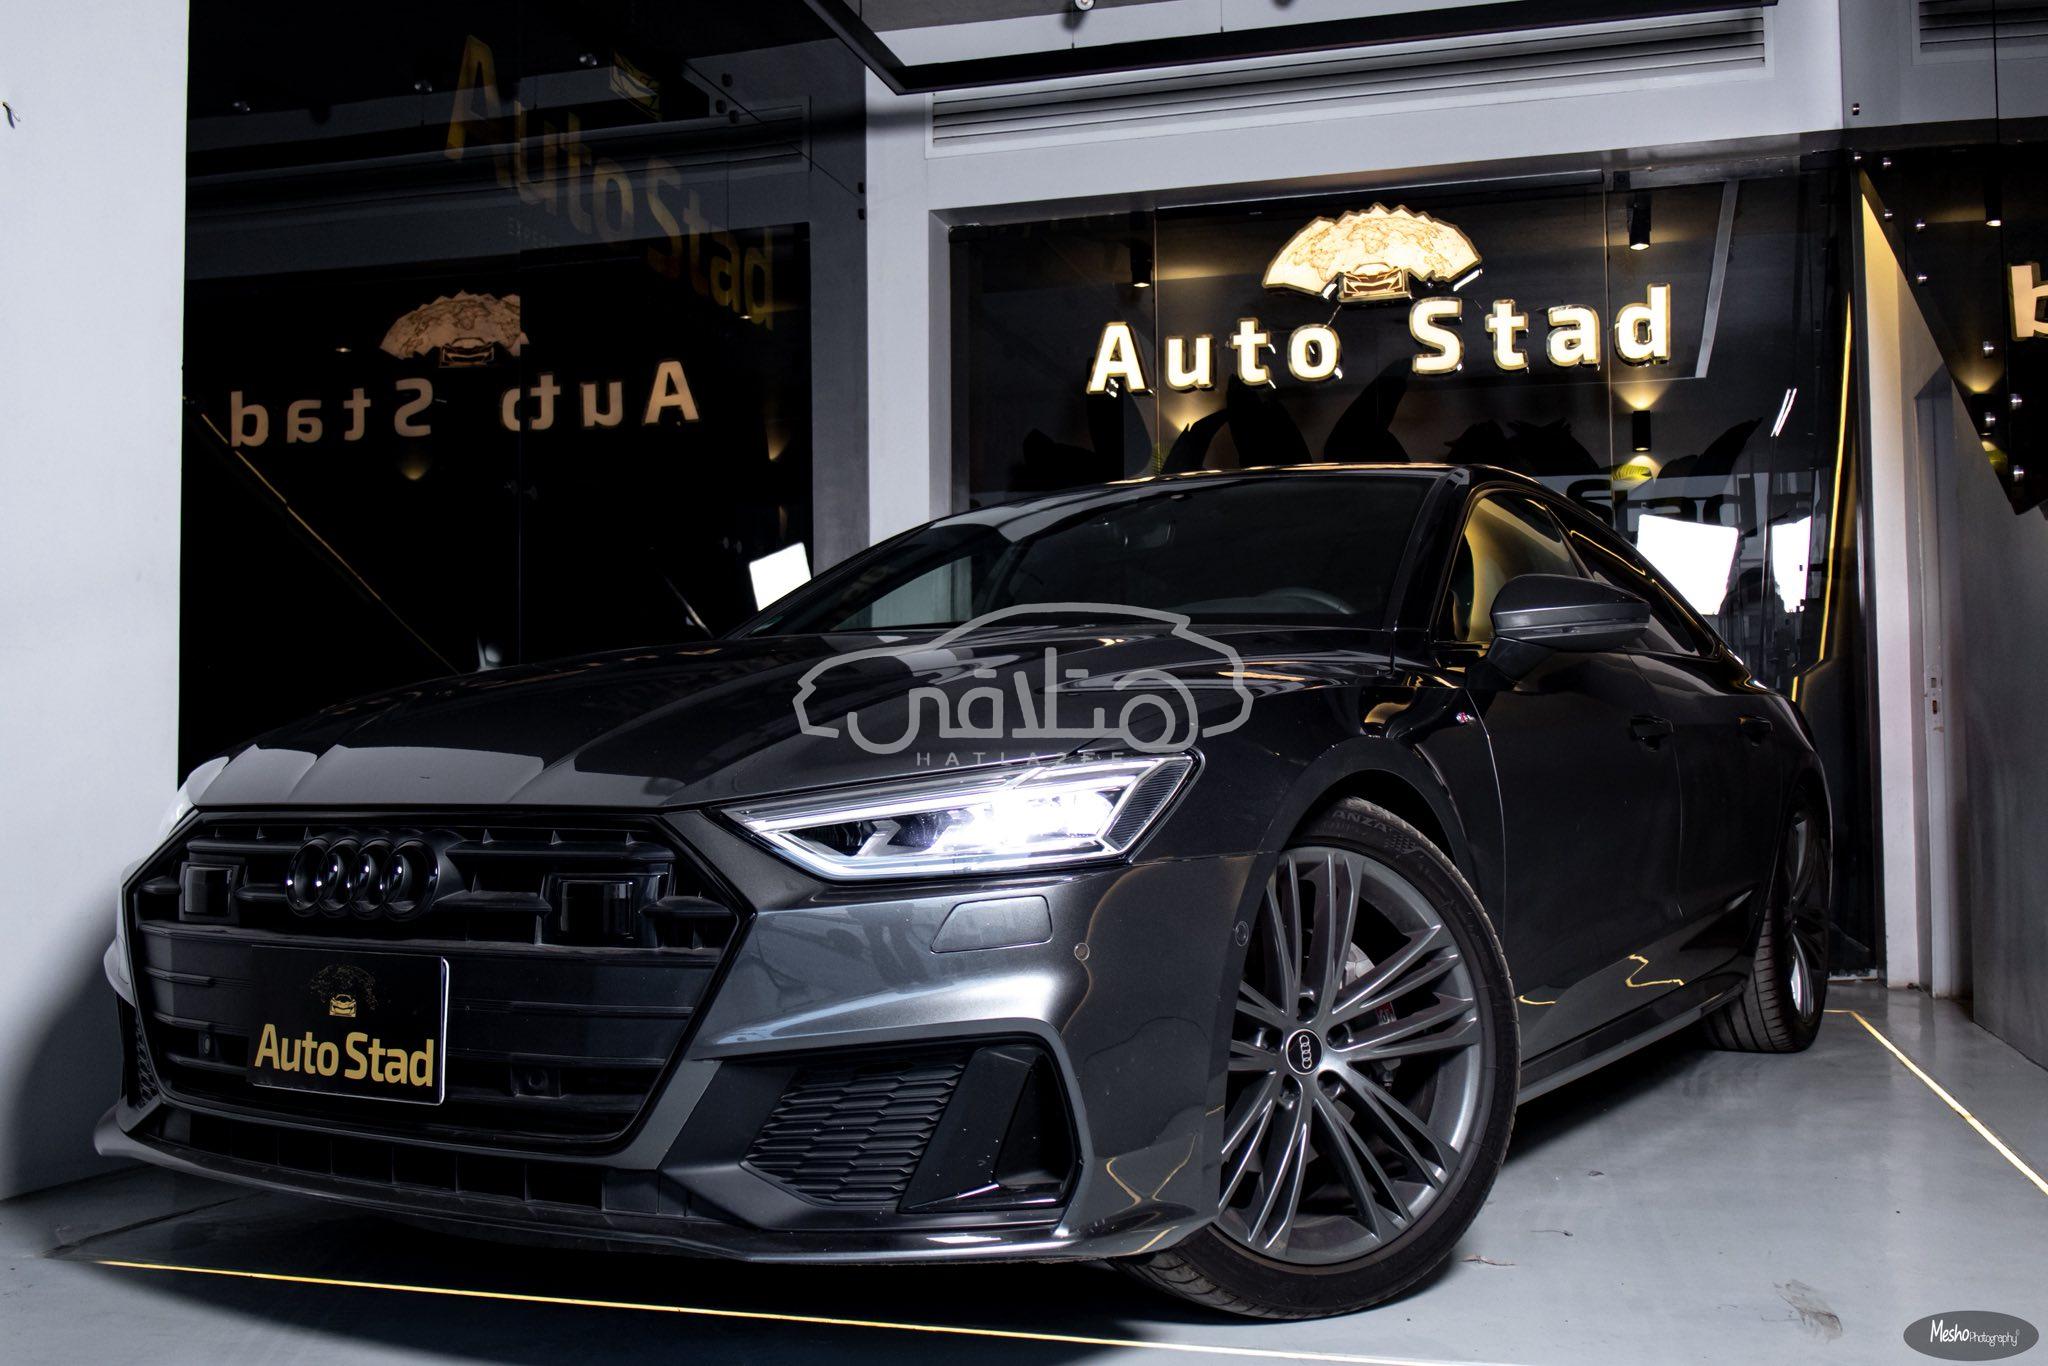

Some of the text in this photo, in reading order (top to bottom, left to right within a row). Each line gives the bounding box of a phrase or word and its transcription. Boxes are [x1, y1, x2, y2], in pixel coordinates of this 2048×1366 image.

[1086, 282, 1674, 397] Auto Stad
[254, 1023, 435, 1088] Auto Stad
